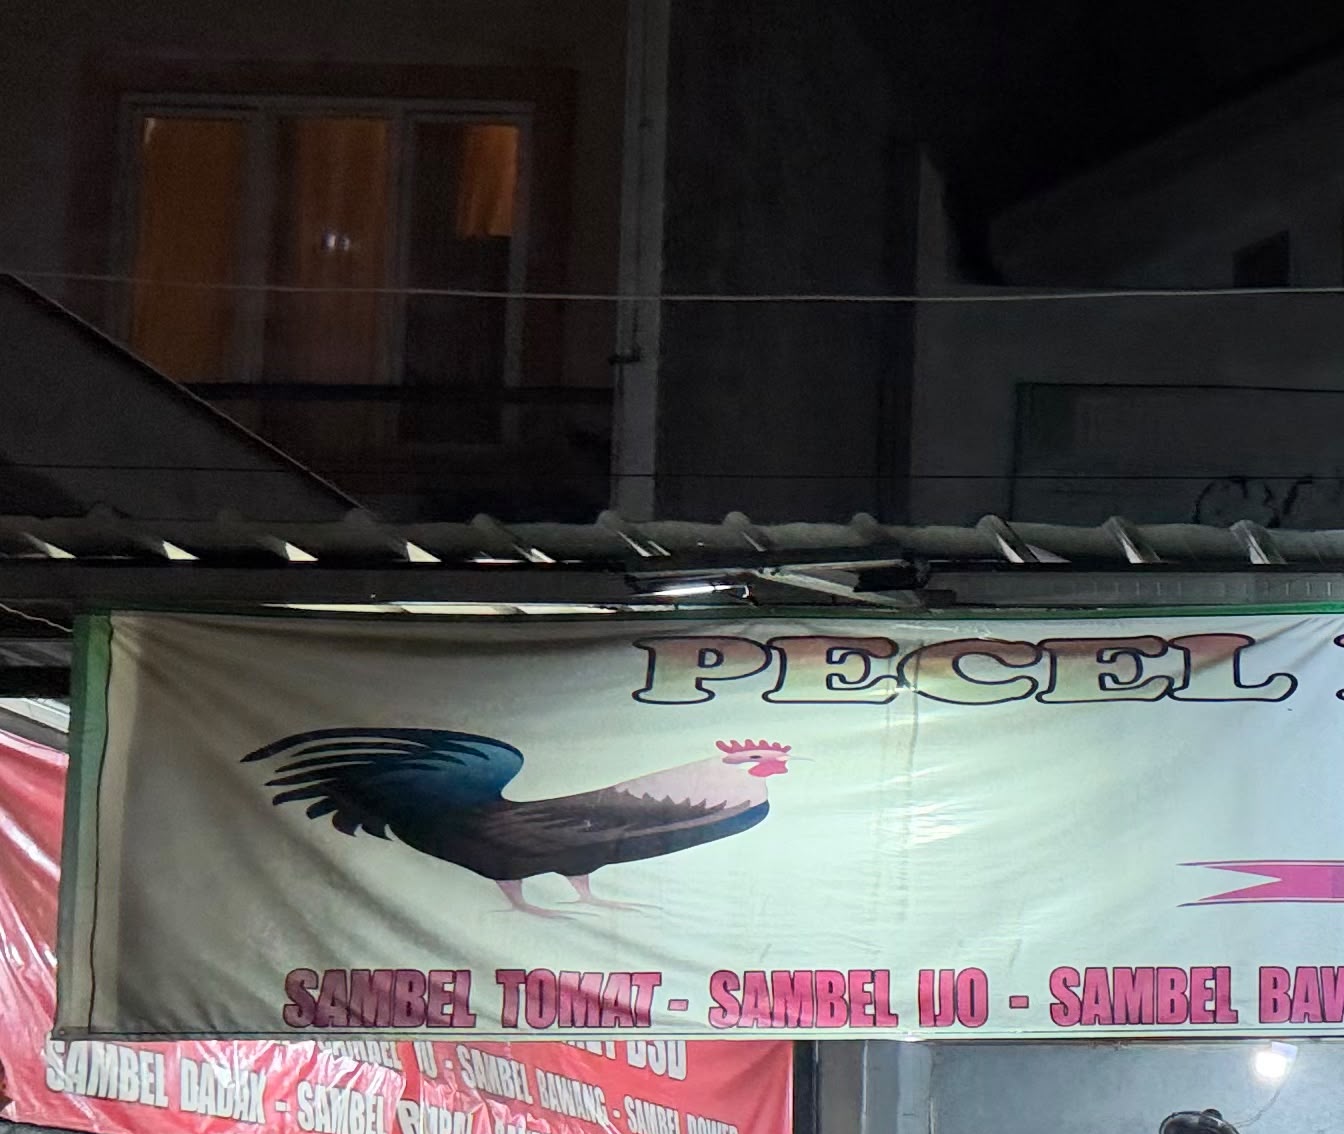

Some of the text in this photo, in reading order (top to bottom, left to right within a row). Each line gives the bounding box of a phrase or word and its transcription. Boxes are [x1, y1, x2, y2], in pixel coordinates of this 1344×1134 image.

[632, 633, 1298, 704] PECEL
[282, 968, 474, 1029] SAMBEL
[495, 969, 663, 1028] TOMAT
[709, 969, 898, 1028] SAMBEL
[918, 967, 989, 1027] IJO
[1049, 966, 1238, 1026] SAMBEL
[45, 1037, 169, 1108] SAMBEL
[456, 1044, 534, 1105] SAMBEL
[536, 1067, 609, 1127] BAWANG
